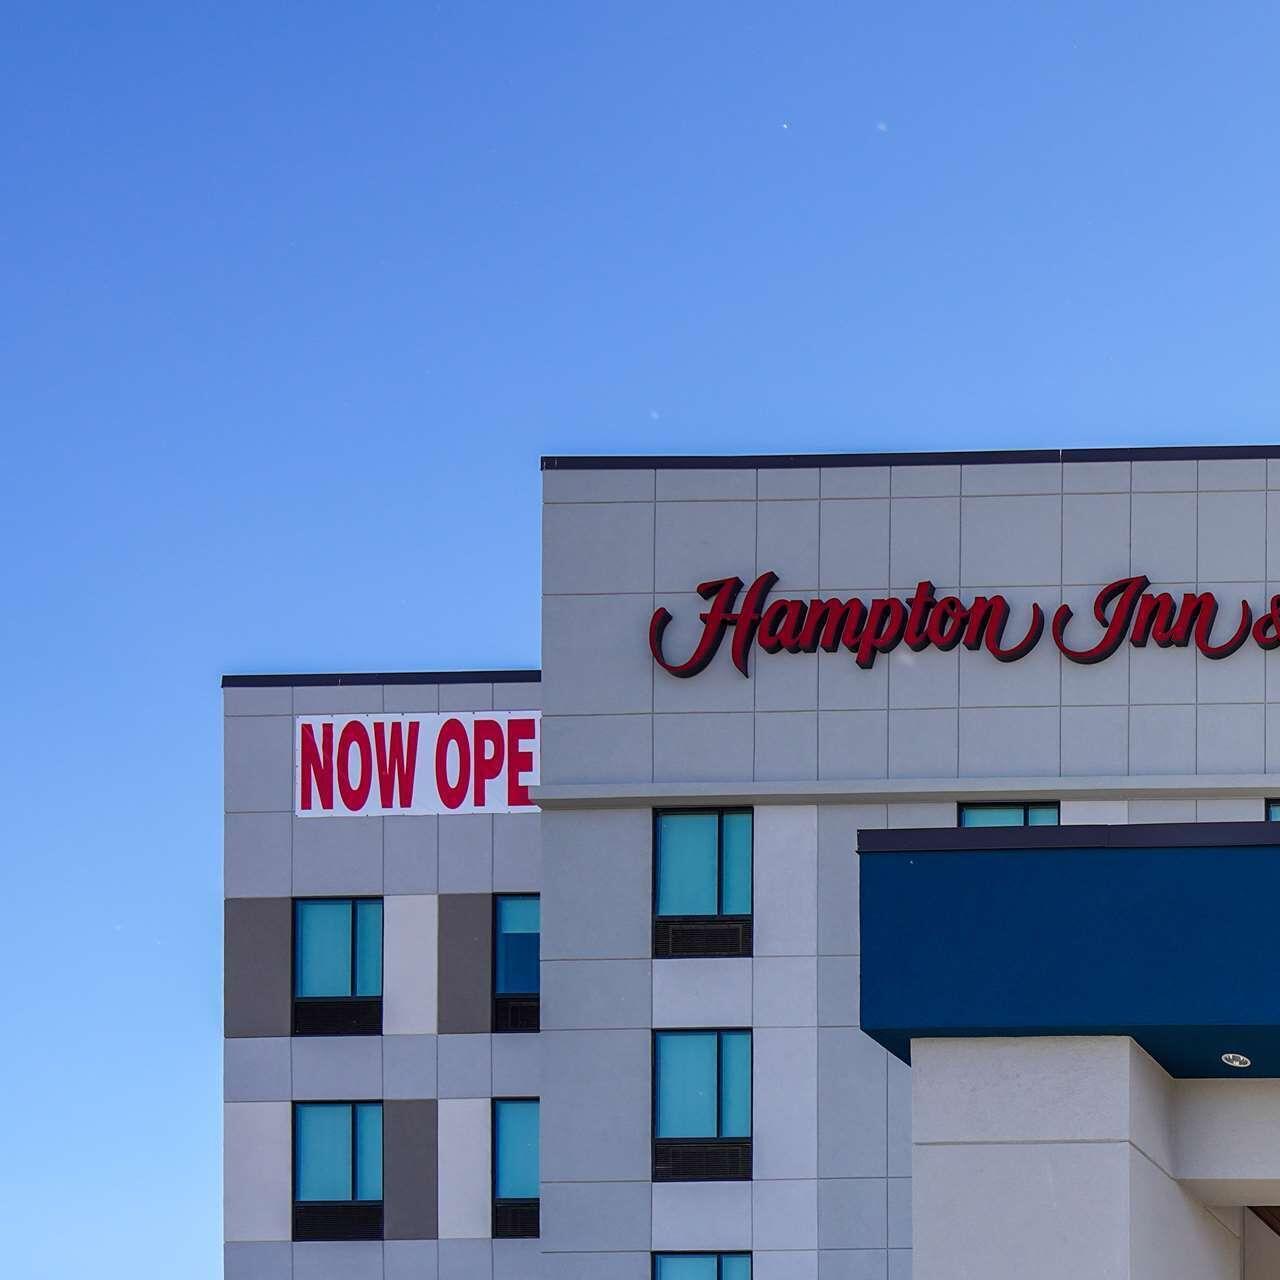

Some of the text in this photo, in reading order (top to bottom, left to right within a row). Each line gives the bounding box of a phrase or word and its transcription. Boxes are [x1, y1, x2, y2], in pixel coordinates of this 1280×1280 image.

[649, 571, 1044, 679] Hampton
[1052, 575, 1252, 664] Inn
[301, 718, 536, 811] NOW OPE
